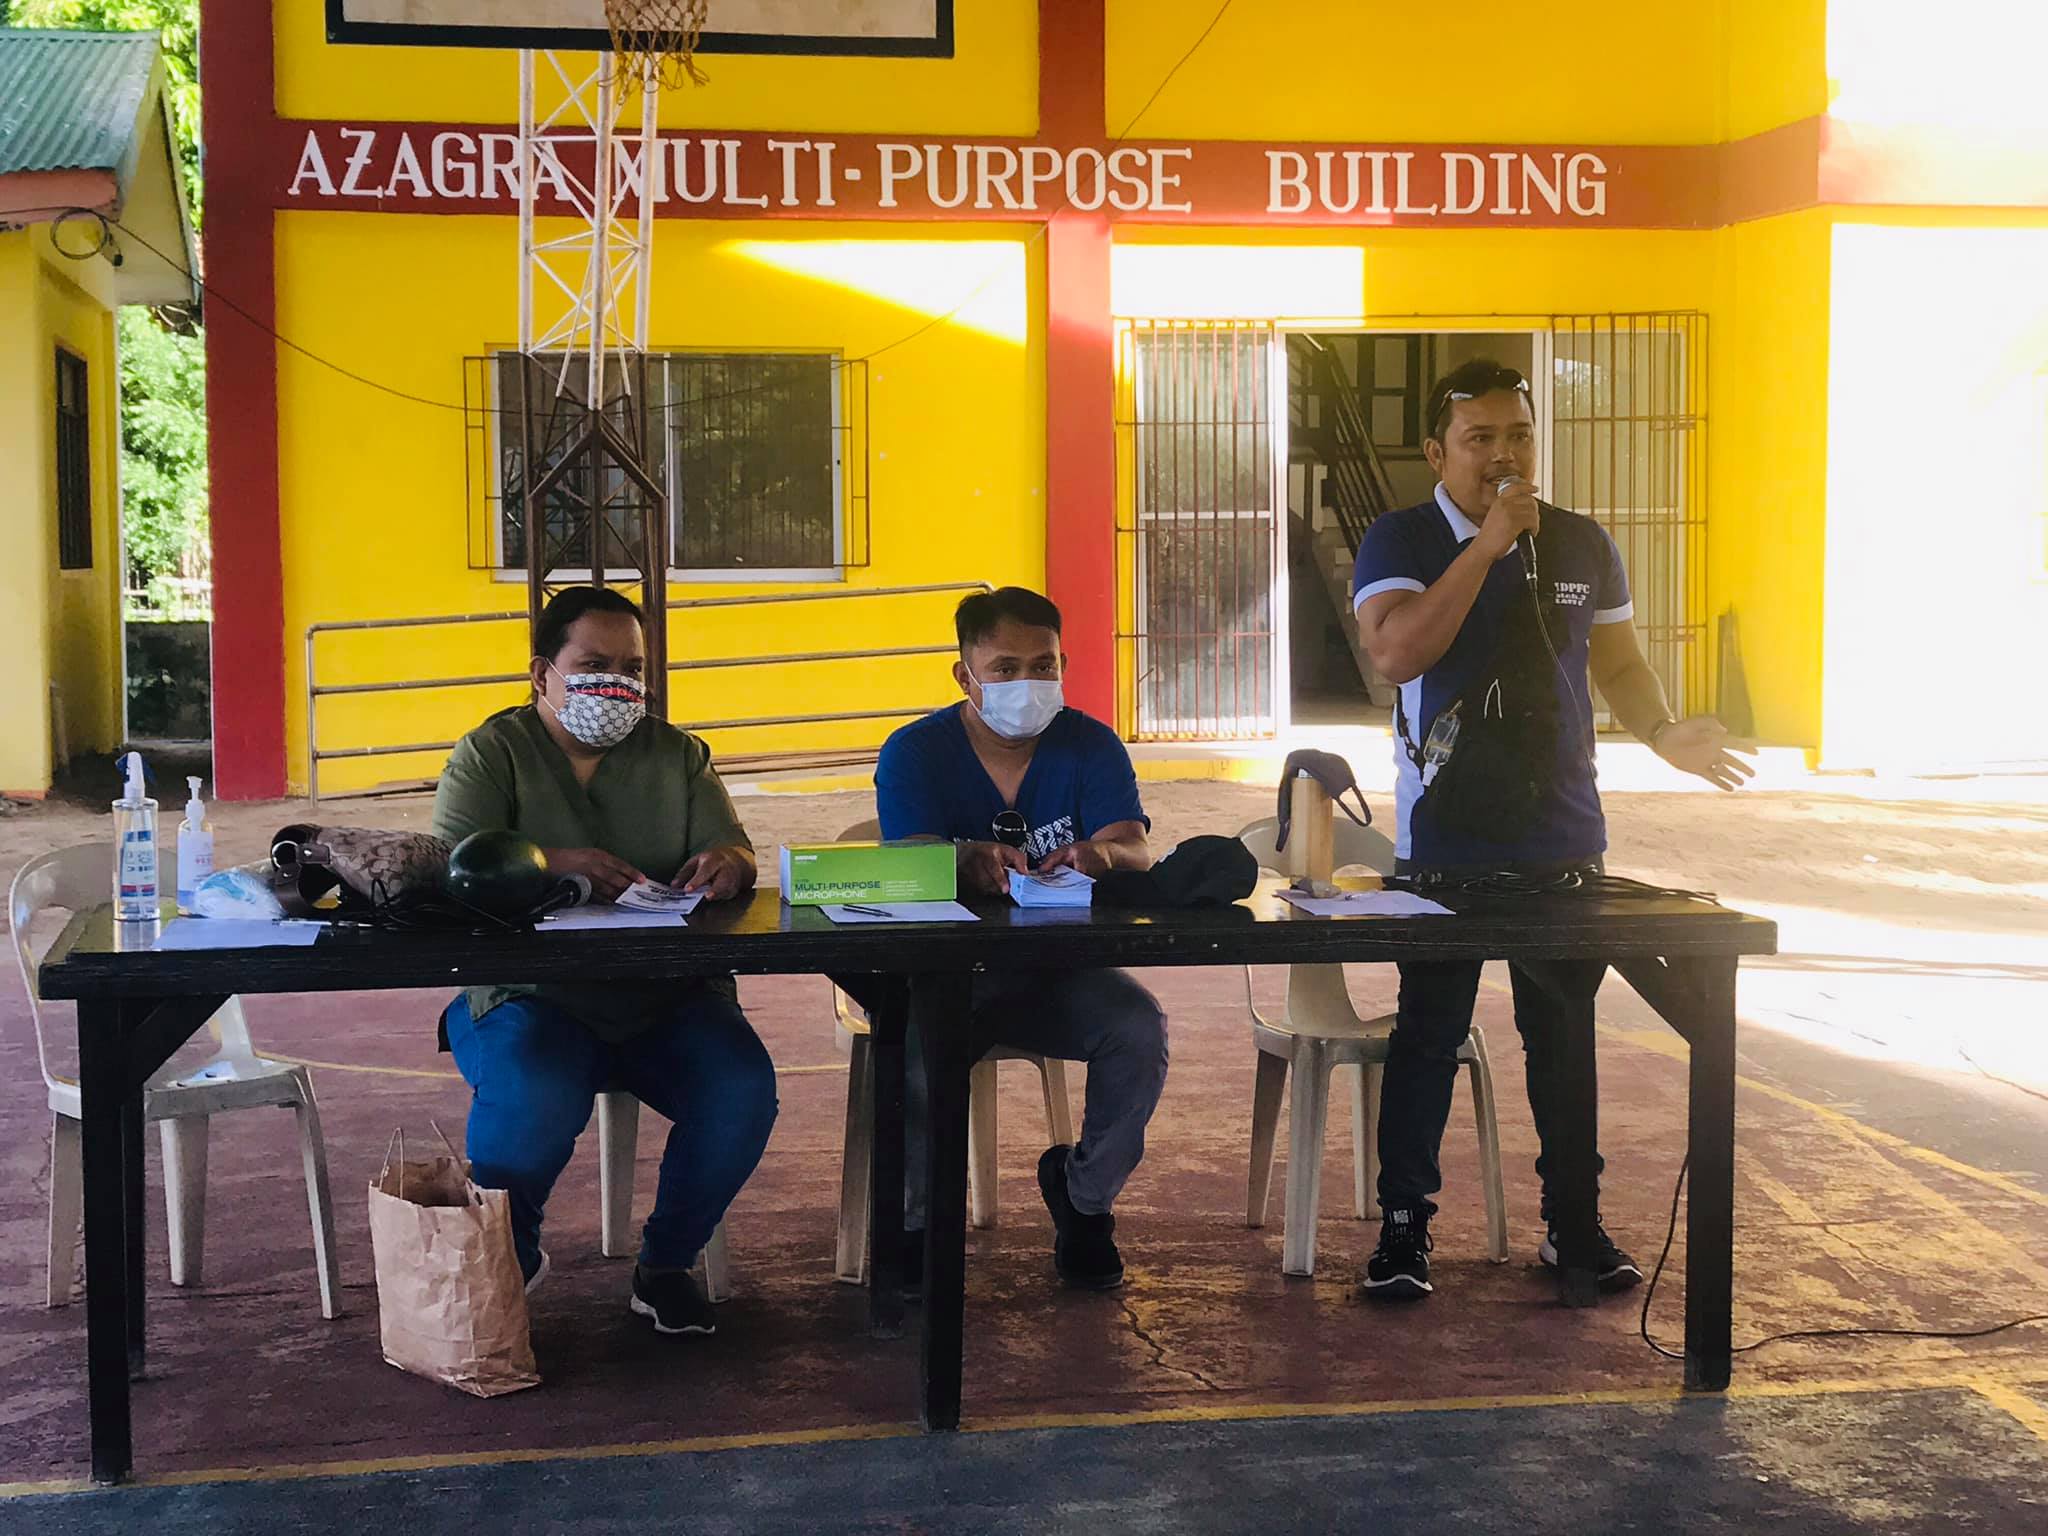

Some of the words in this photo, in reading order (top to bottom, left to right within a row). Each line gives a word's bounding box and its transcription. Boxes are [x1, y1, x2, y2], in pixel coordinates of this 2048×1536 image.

[287, 127, 573, 200] AZAGRA
[1265, 150, 1608, 217] BUILDING
[795, 880, 881, 891] MULTI-PURPOSE
[795, 889, 867, 900] MICROPHONE
